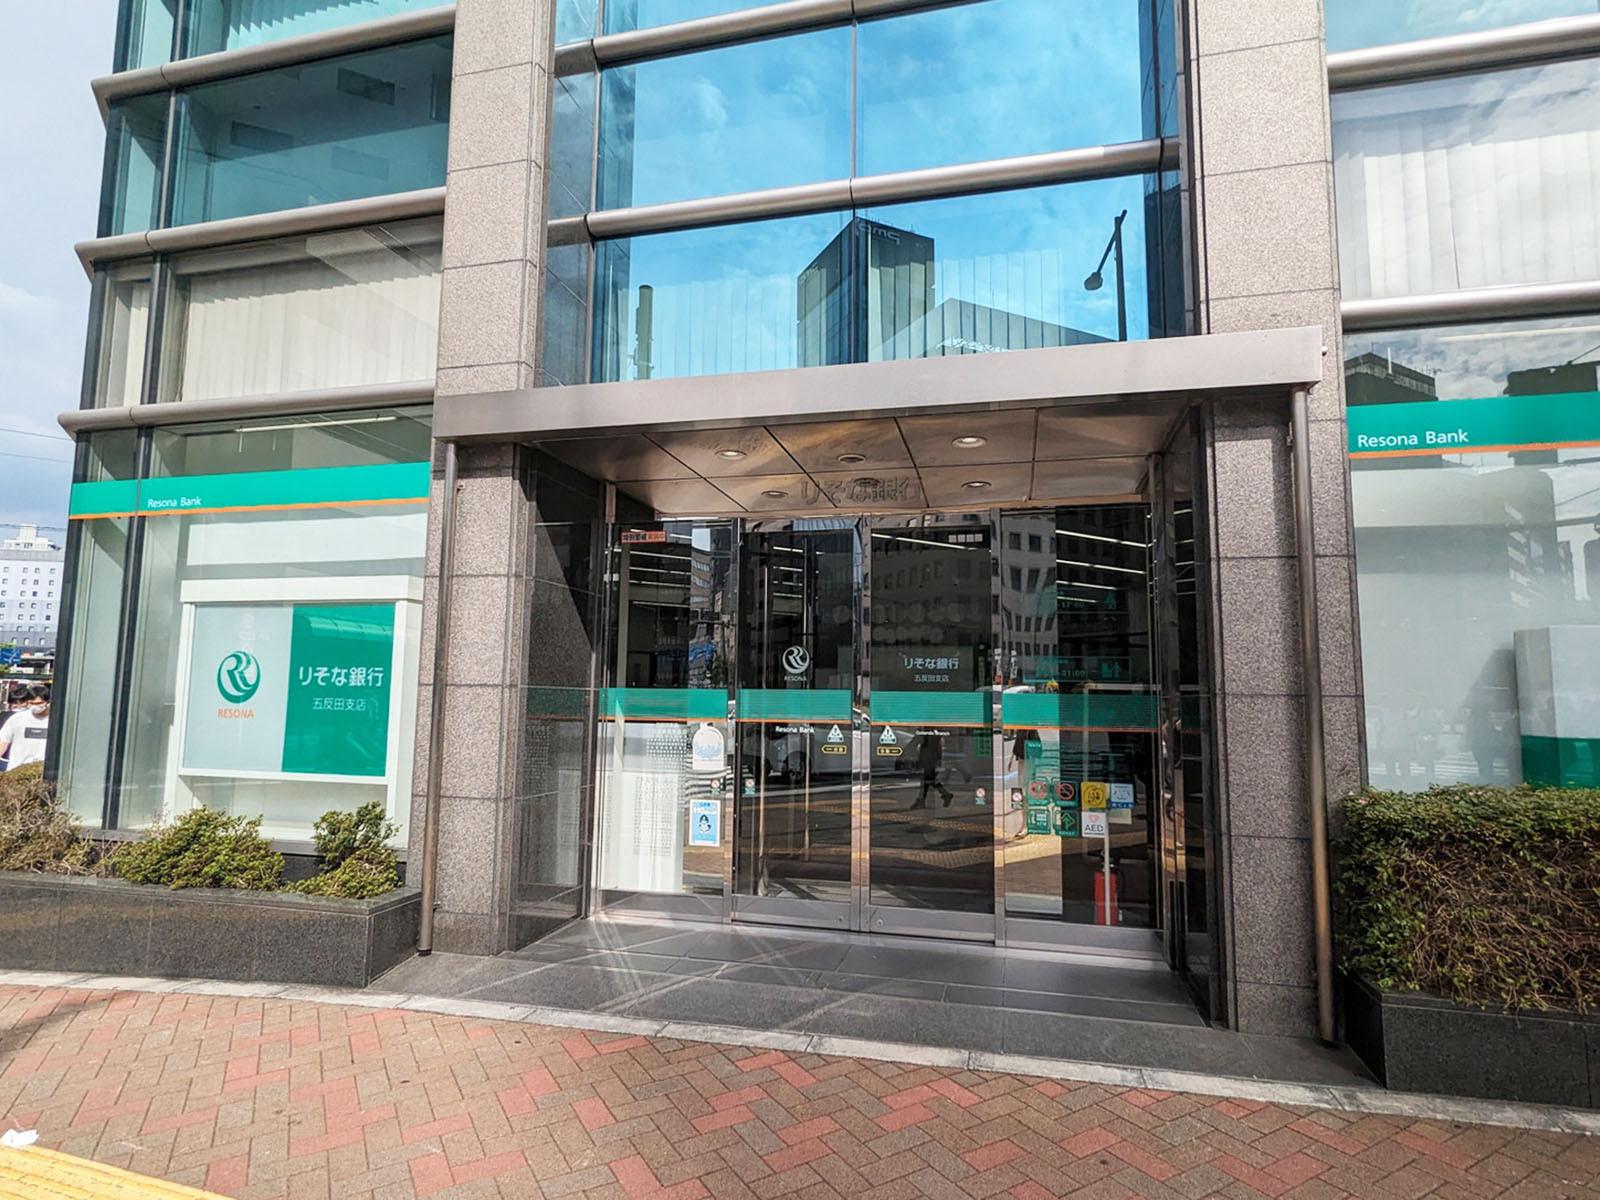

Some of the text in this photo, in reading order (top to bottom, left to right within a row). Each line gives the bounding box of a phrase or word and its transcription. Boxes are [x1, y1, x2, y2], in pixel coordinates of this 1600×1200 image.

[1358, 428, 1469, 448] Resona Bank
[148, 496, 202, 508] Resona Bank
[904, 657, 960, 669] りそな銀行
[299, 666, 384, 687] りそな銀行
[312, 697, 367, 711] 五反田支店
[217, 708, 254, 718] RESONA
[1084, 824, 1104, 832] AED
